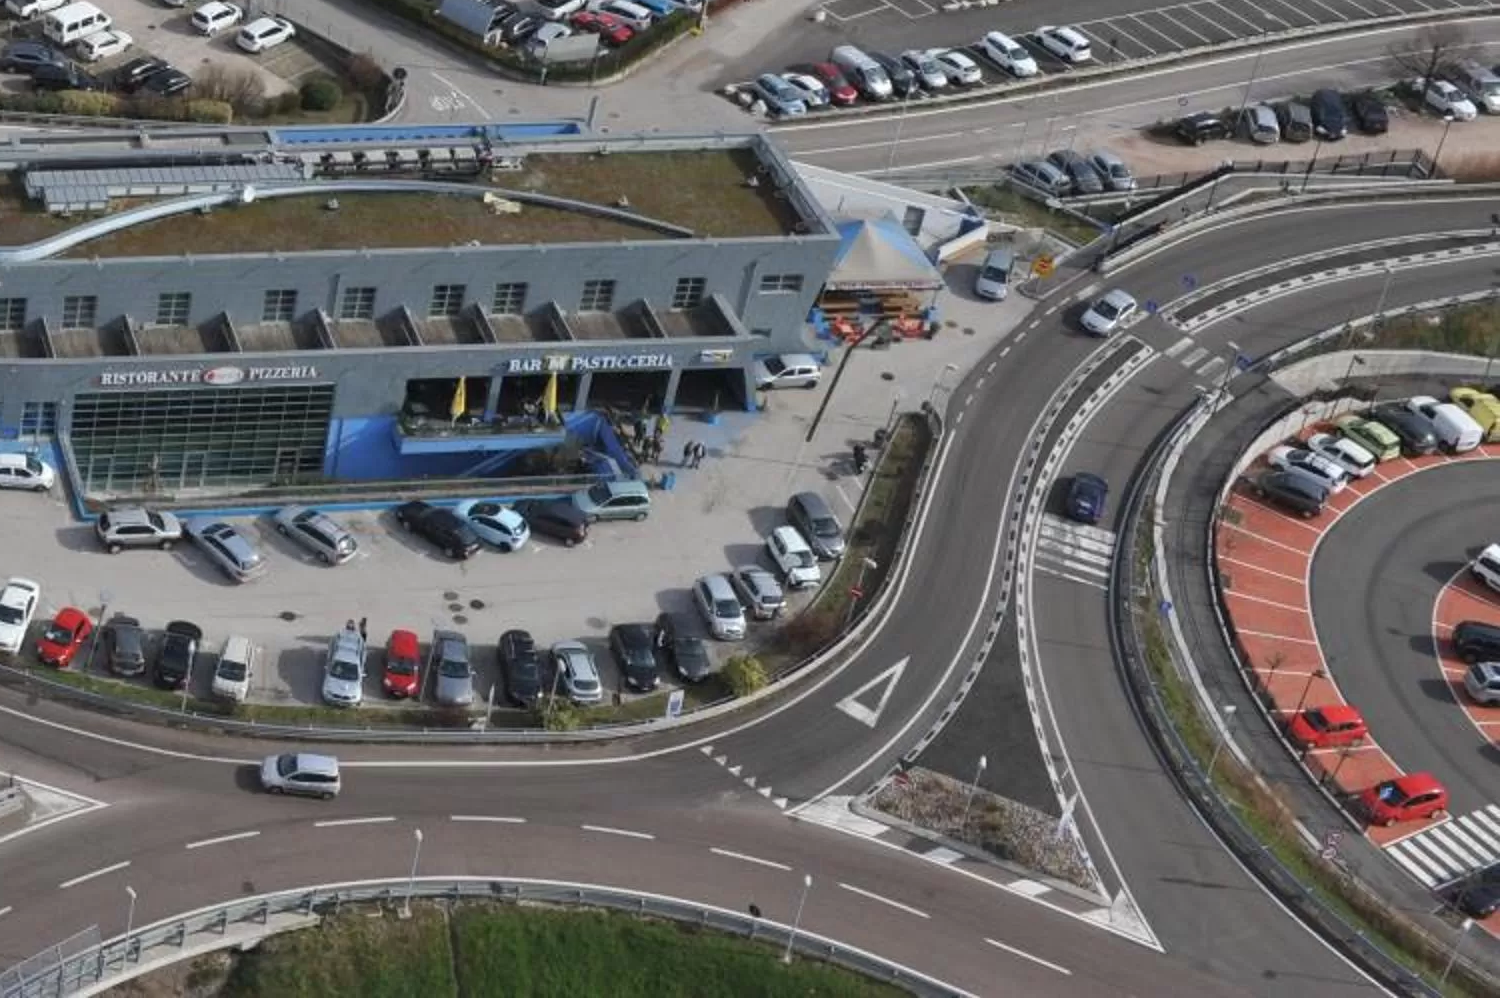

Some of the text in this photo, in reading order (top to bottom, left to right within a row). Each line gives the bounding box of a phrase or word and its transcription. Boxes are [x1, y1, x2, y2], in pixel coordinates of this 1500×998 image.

[508, 358, 542, 372] BAR
[571, 354, 674, 370] PASTICCERIA
[100, 370, 201, 386] RISTORANTE
[249, 365, 317, 379] PIZZERIA
